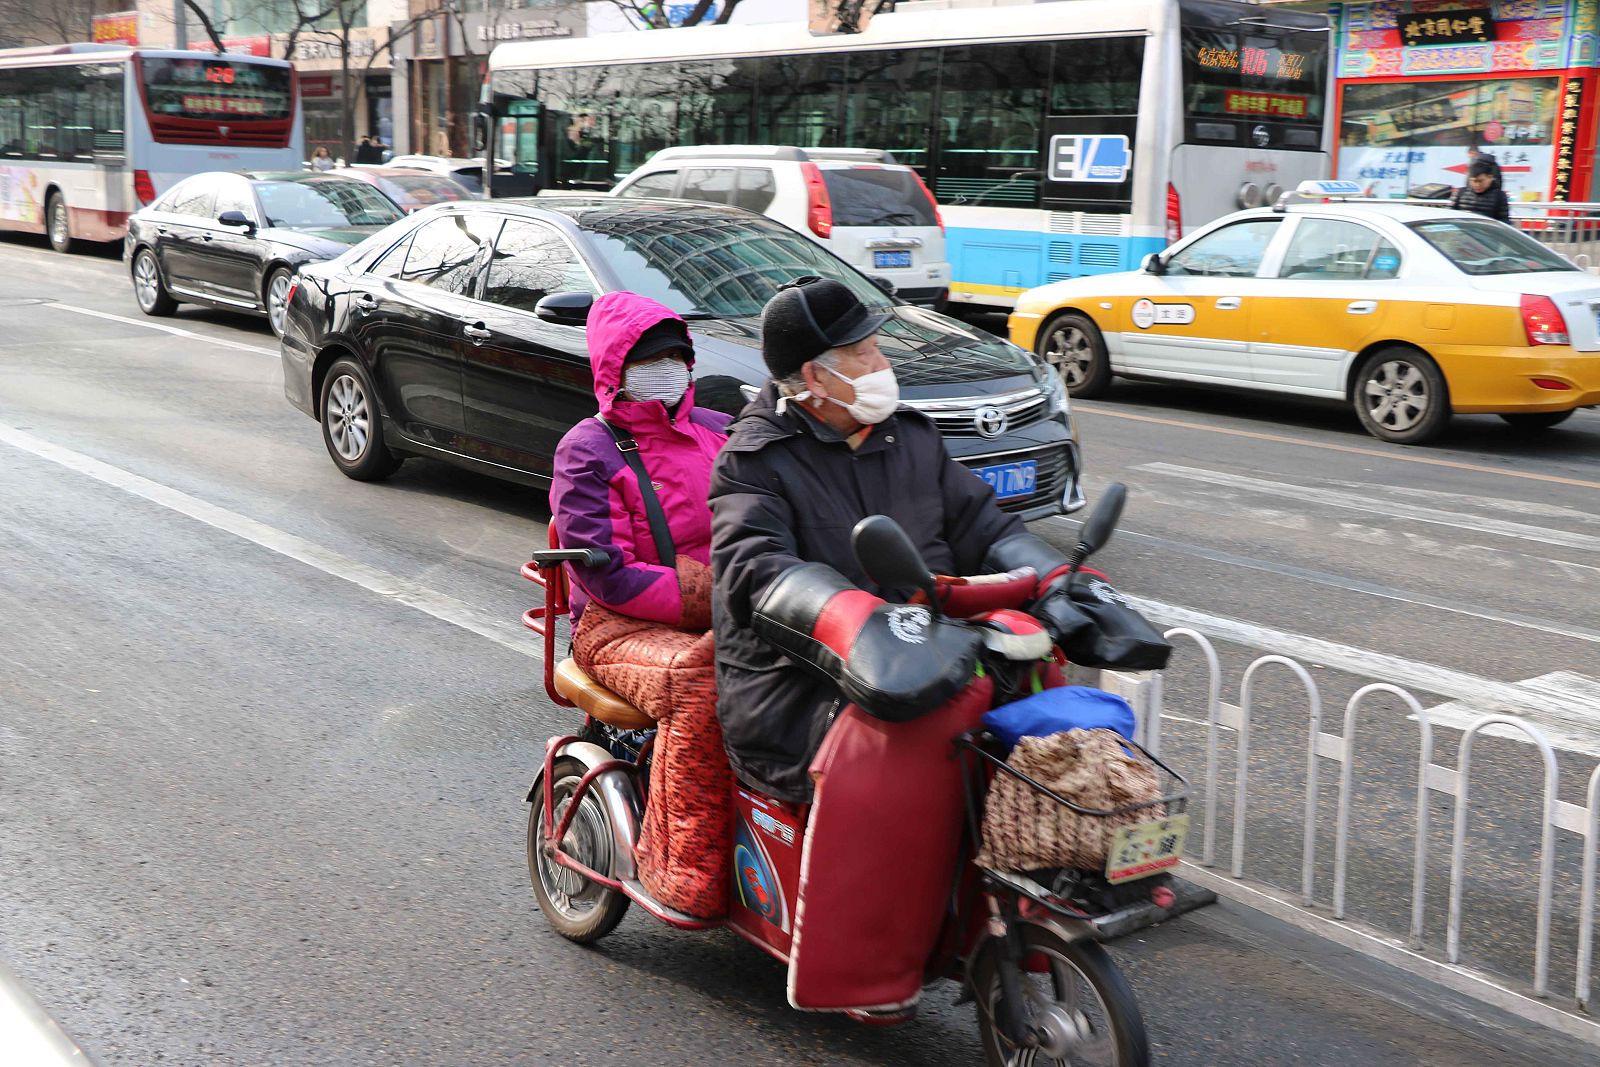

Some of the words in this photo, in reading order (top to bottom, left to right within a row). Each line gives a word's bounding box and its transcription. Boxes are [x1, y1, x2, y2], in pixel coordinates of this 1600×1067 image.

[1404, 16, 1486, 38] 北京同仁堂
[1197, 47, 1240, 69] 北京南站
[1241, 47, 1268, 76] 106
[1053, 137, 1101, 179] EV
